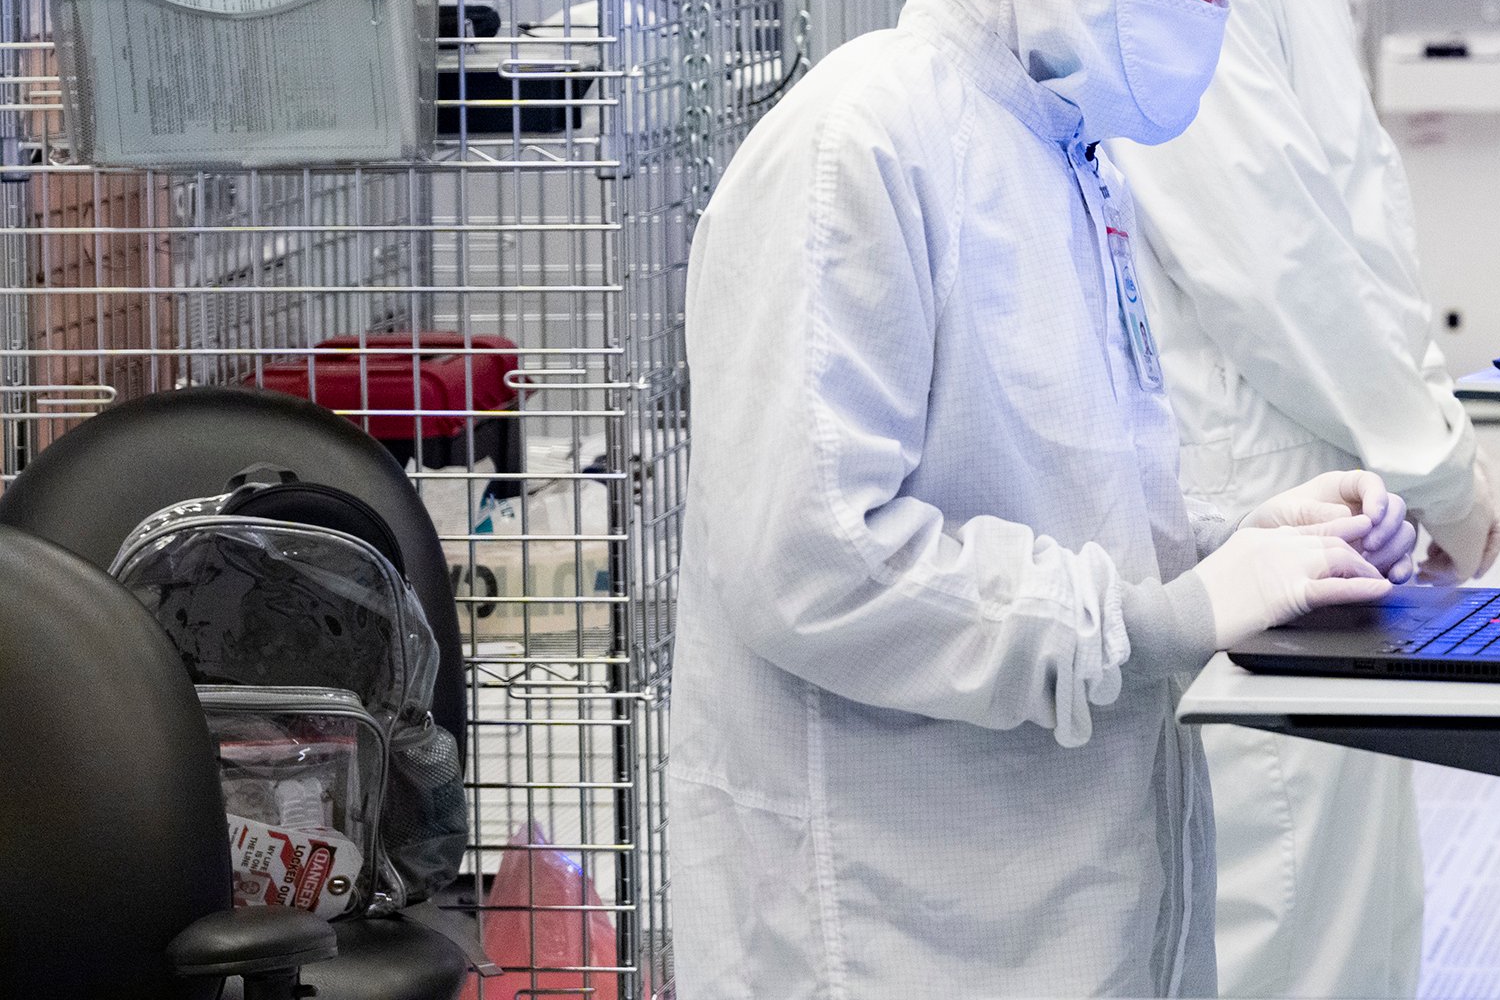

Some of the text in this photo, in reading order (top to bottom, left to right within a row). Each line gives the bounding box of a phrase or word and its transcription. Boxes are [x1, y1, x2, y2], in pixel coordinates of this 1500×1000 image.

[240, 837, 258, 867] THE LINE
[250, 850, 263, 871] IS ON
[260, 845, 276, 872] MY LIFE
[276, 845, 306, 906] LOCKED OUT
[301, 852, 328, 909] DANGER
